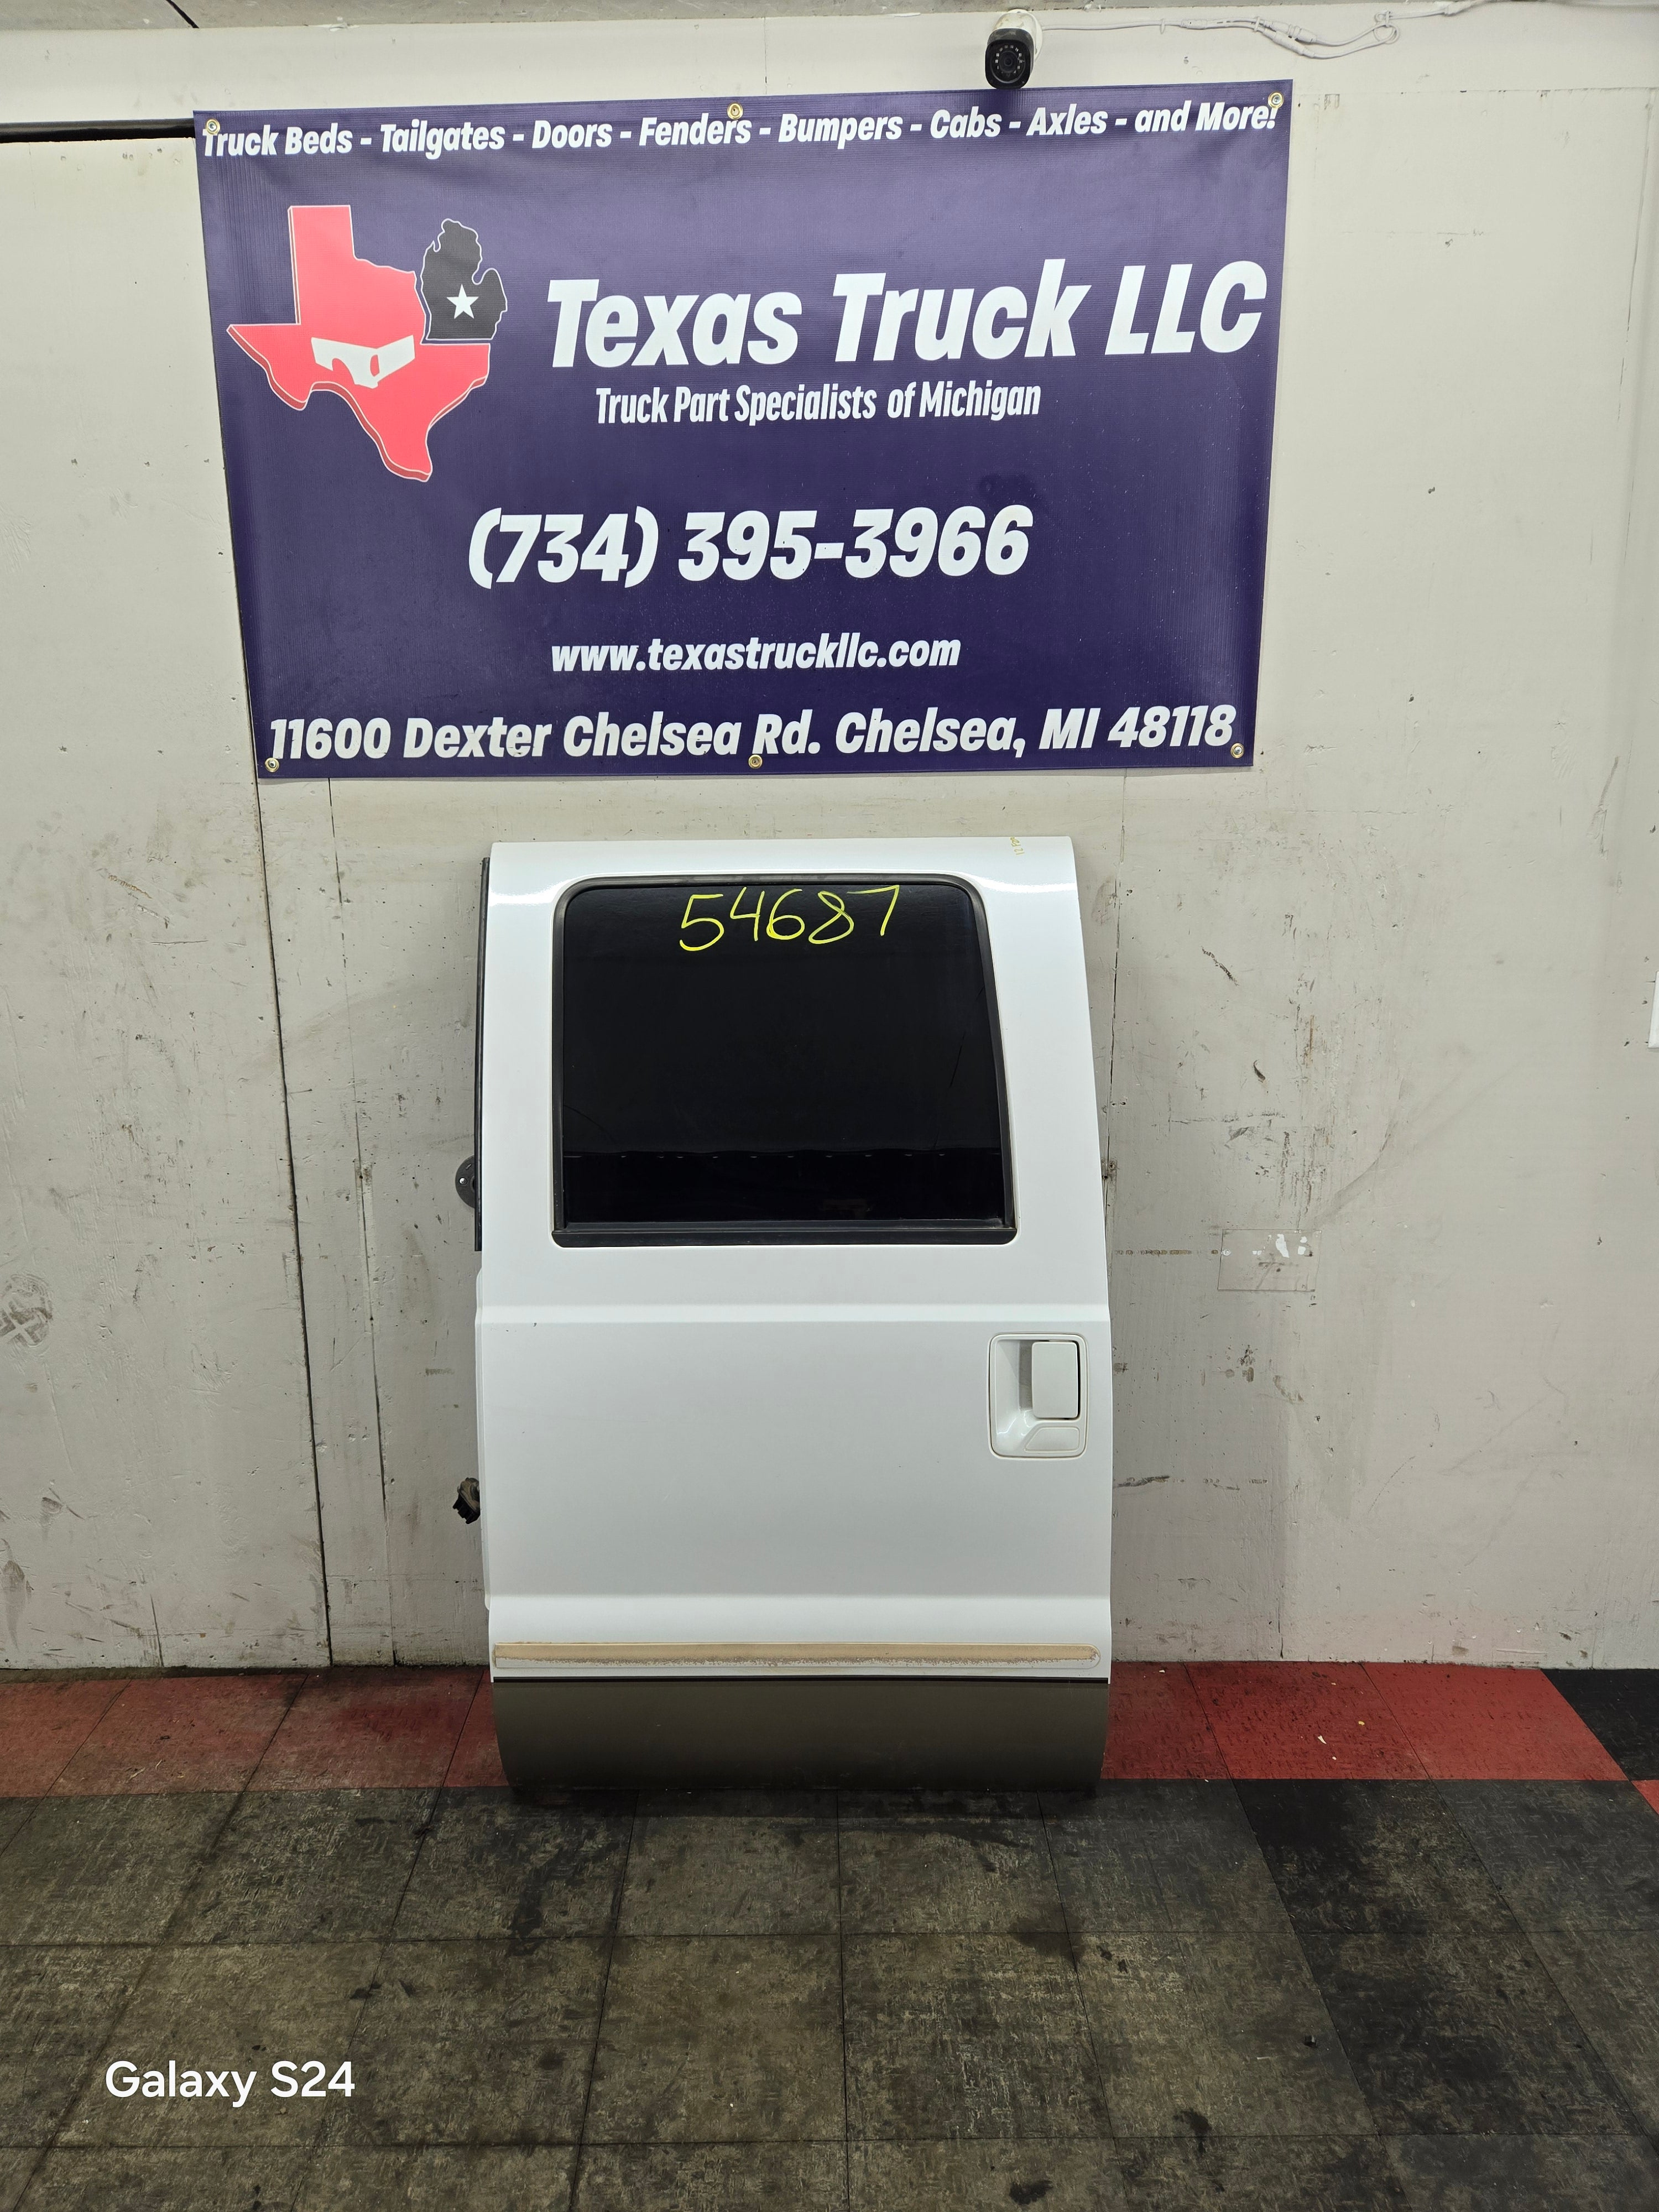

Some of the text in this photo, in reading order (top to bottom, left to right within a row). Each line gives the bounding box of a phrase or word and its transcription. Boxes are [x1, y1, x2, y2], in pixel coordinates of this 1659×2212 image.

[202, 124, 279, 156] Truck
[285, 122, 353, 155] Beds
[380, 118, 505, 160] Tailgates
[531, 120, 613, 149] Doors
[639, 112, 753, 147] Fenders
[778, 113, 903, 150] Bumpers
[930, 106, 1002, 139] Cabs
[1026, 103, 1108, 136] Axles
[1134, 100, 1192, 133] and
[1195, 101, 1278, 131] More!
[547, 258, 1267, 368] Texas Truck LLC
[596, 379, 1041, 426] Truck Part Specialists of Michigan
[468, 504, 1034, 589] (734) 395-3966
[551, 632, 961, 672] www.texastruckllc.com
[270, 704, 1237, 760] 11600 Dexter Chelsea Rd. Chelsea, MI 48118
[679, 884, 900, 952] 54687
